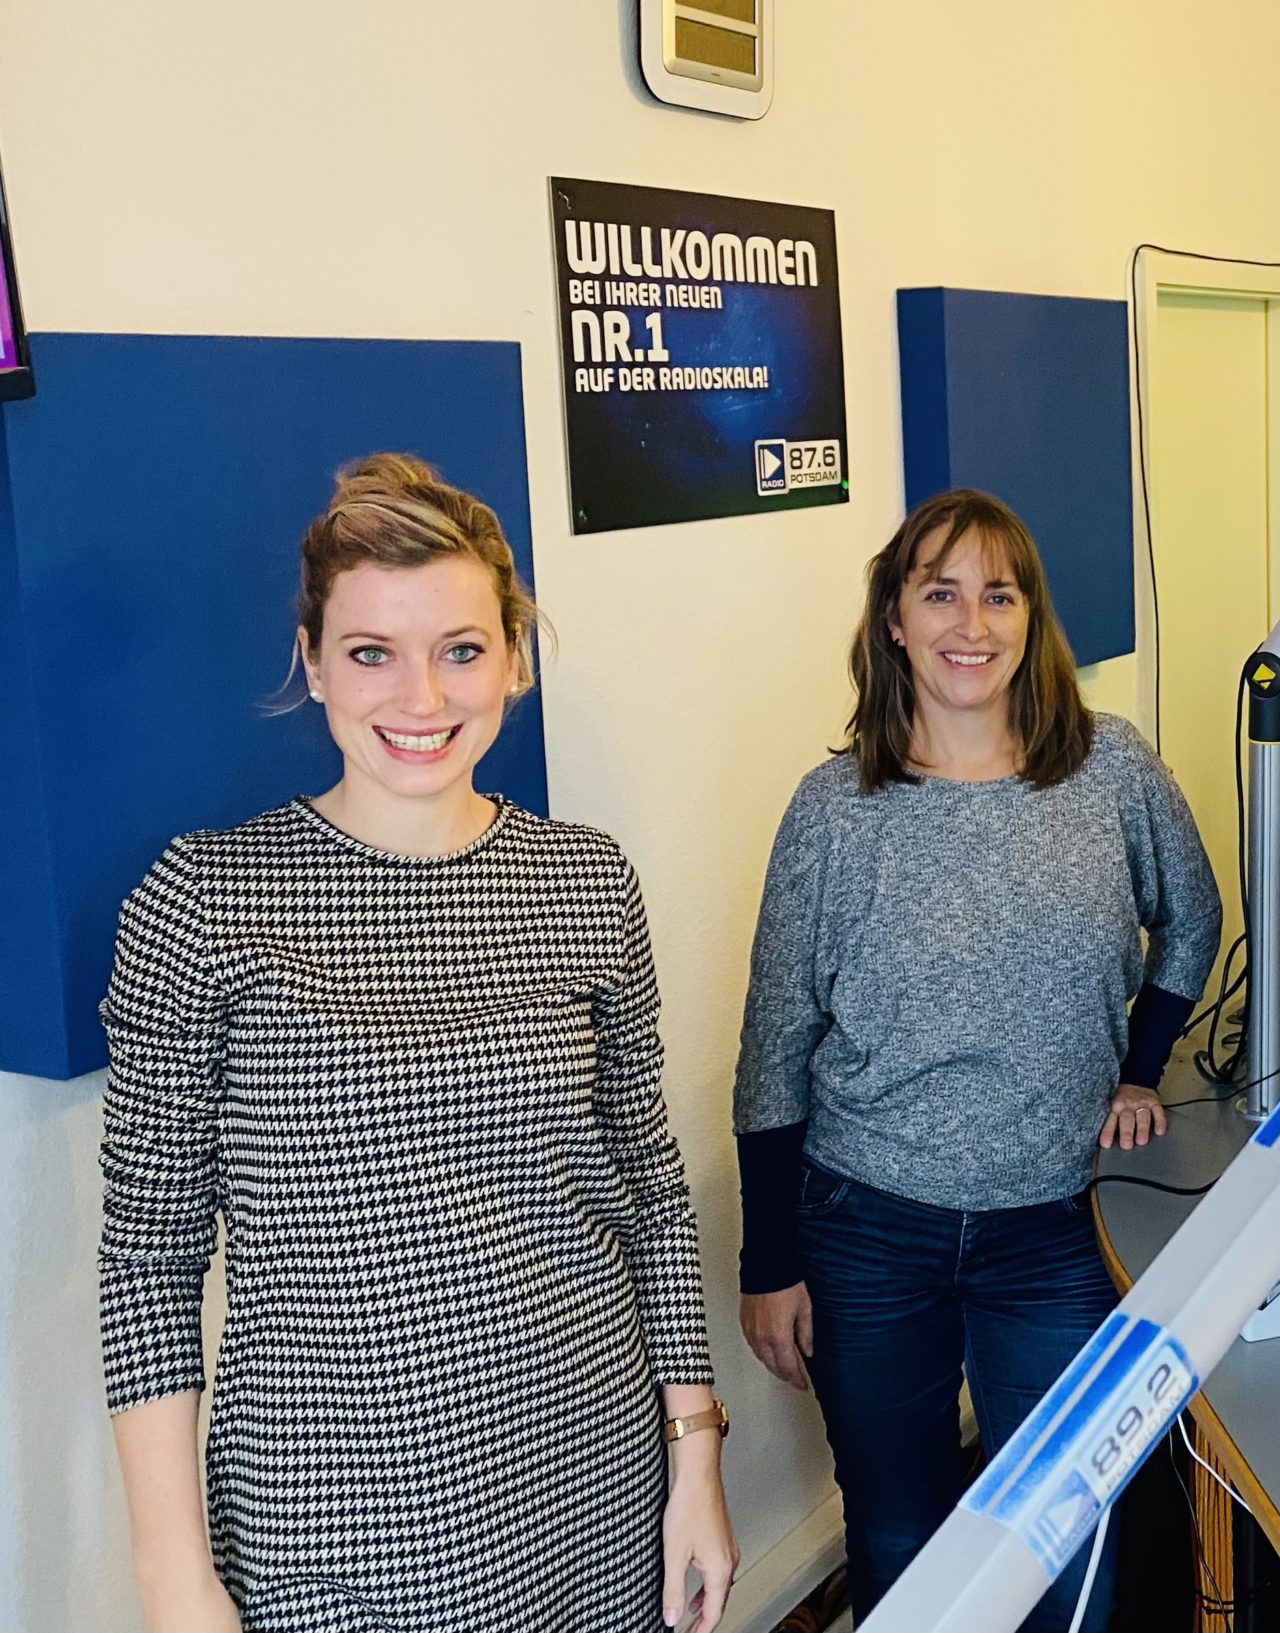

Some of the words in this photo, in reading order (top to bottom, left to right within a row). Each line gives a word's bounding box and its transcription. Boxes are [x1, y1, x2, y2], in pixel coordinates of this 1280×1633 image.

[565, 219, 818, 286] WILLKOMMEN
[569, 279, 600, 304] BEI
[605, 281, 662, 307] IHRER
[665, 284, 723, 309] NEUEN
[571, 310, 669, 363] NR.1
[575, 368, 614, 393] AUF
[619, 367, 656, 391] DER
[659, 366, 769, 390] RADIOSKALA!
[789, 446, 836, 470] 87.6
[762, 480, 784, 488] RADIO
[790, 470, 838, 484] POTSDAM
[1091, 1363, 1178, 1477] 89.2
